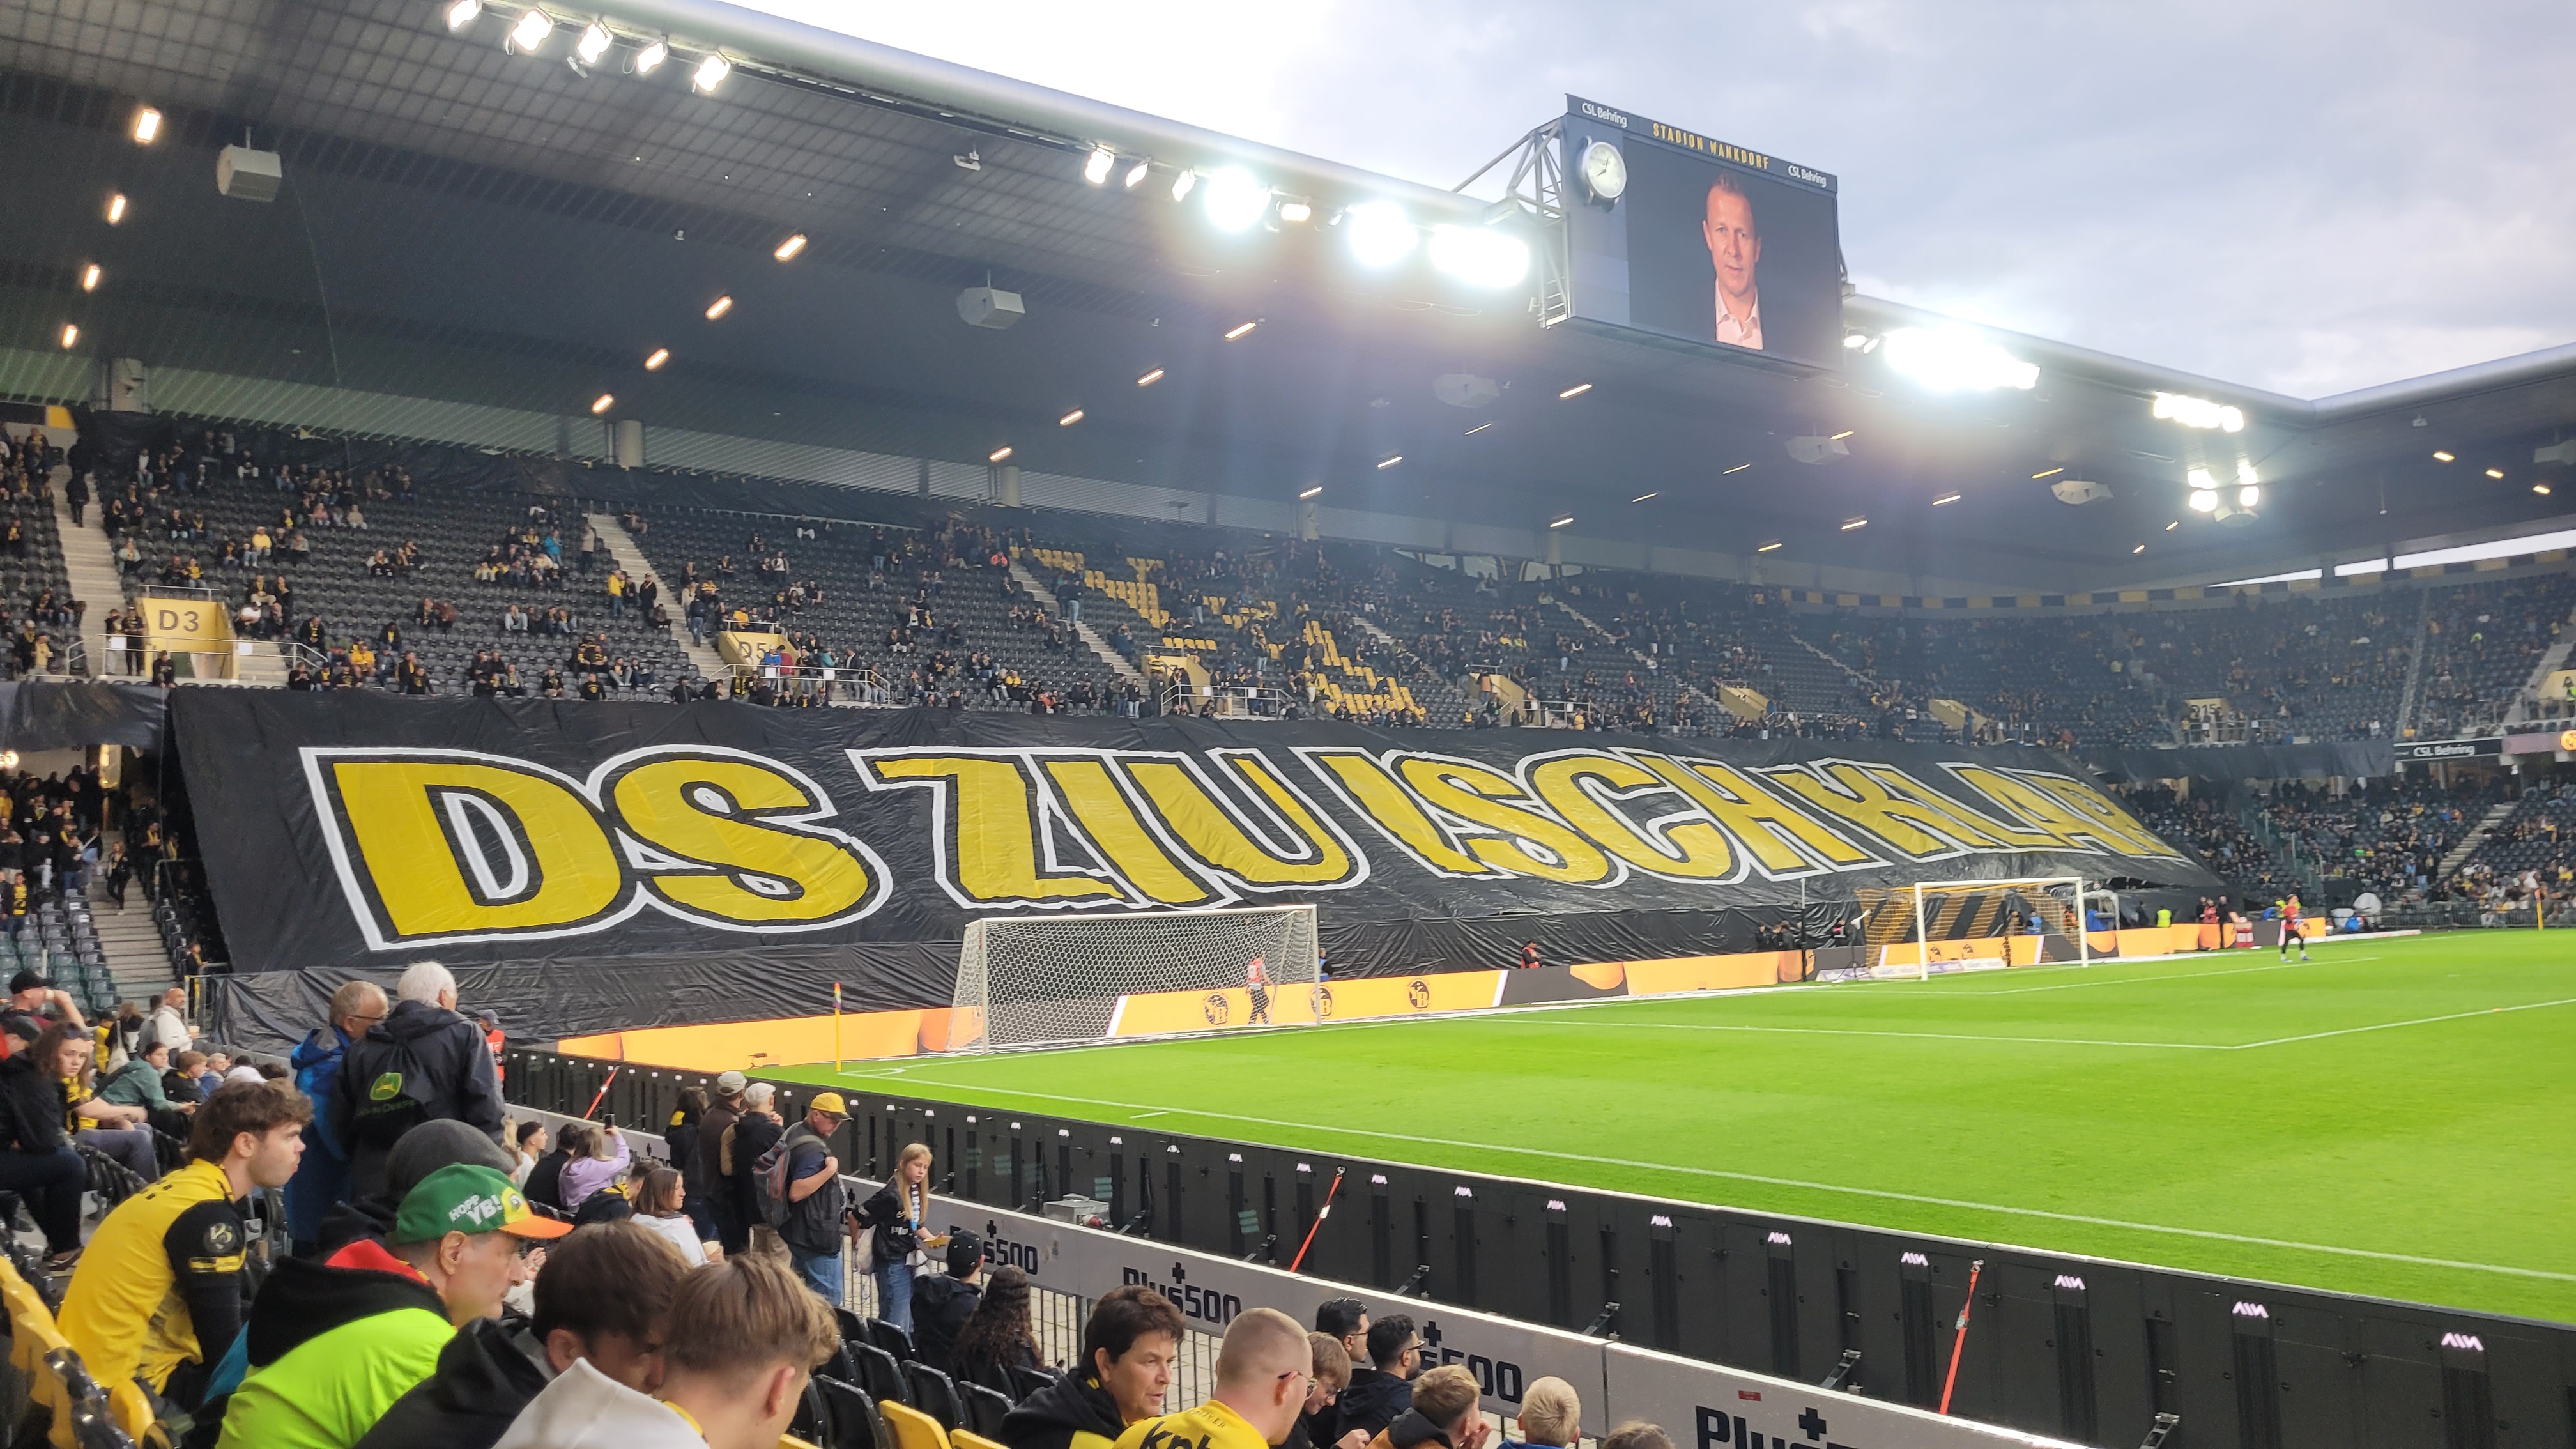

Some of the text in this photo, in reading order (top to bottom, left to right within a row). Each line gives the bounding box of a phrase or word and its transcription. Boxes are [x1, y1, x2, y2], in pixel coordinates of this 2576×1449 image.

[1582, 102, 1627, 128] CSL Behring
[1653, 123, 1768, 170] STADION WANKDORF
[1788, 165, 1827, 188] CSL Behring
[159, 610, 199, 632] D3
[2413, 747, 2433, 757] CSL
[2434, 744, 2475, 756] Behring
[298, 744, 893, 951] DS
[448, 1194, 480, 1223] HOPP
[466, 1194, 503, 1225] YB!
